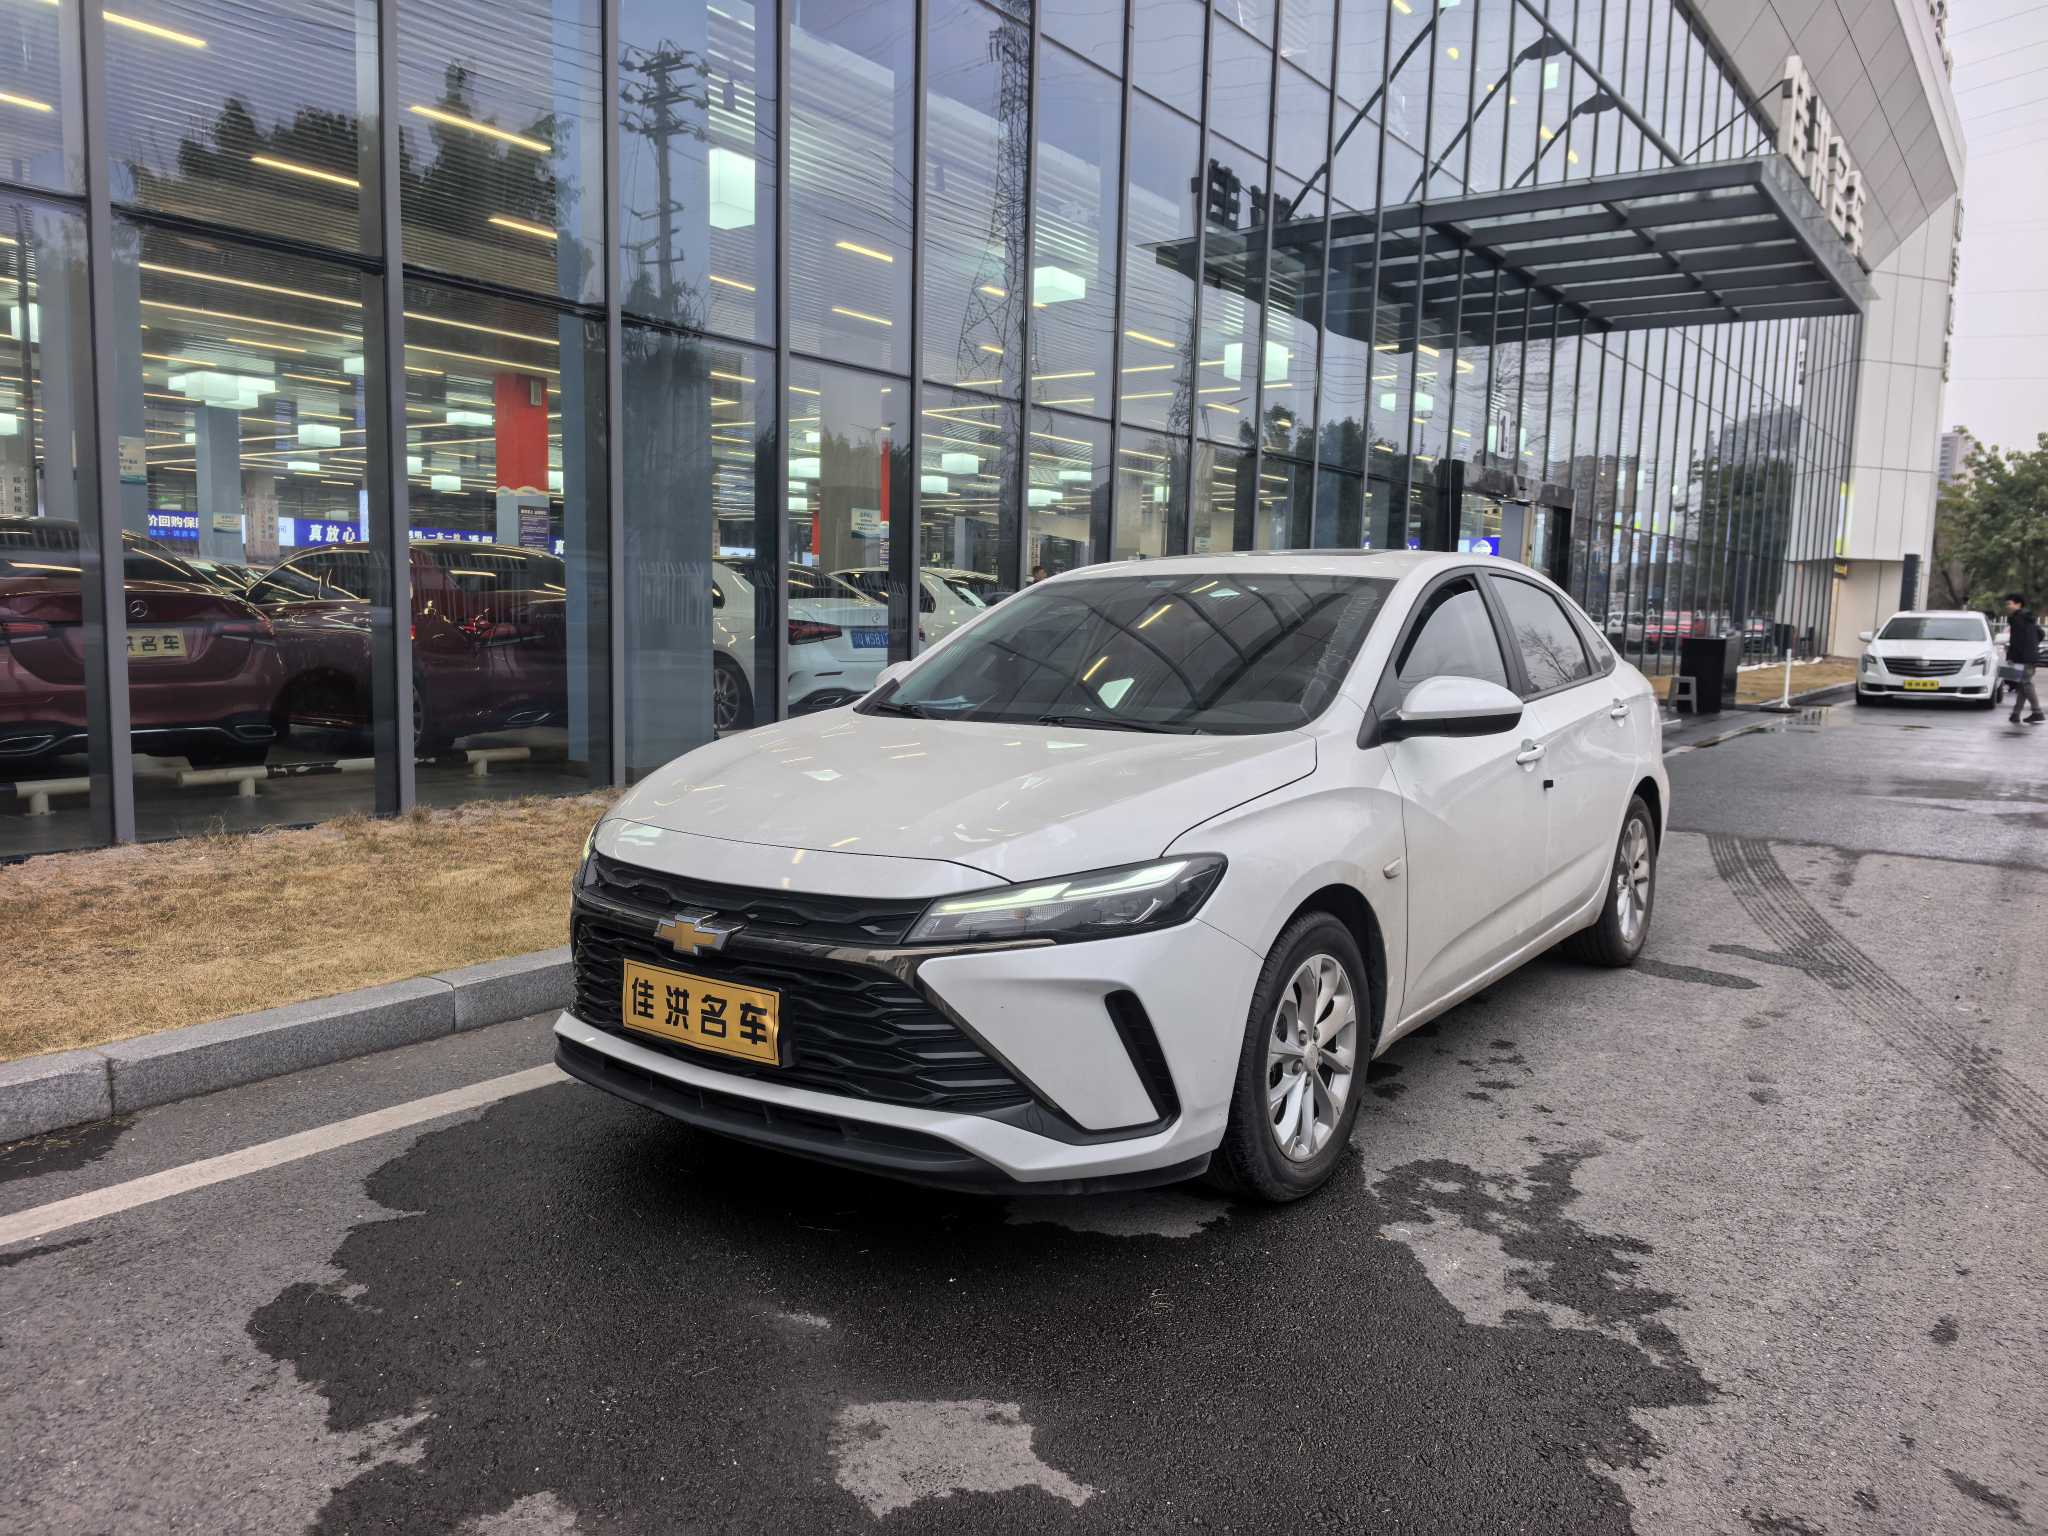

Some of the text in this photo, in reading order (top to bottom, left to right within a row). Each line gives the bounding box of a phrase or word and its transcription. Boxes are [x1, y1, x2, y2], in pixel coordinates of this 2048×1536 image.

[1780, 54, 1866, 257] 佳洪名车
[308, 524, 356, 543] 真放心
[631, 976, 768, 1045] 佳洪名车
